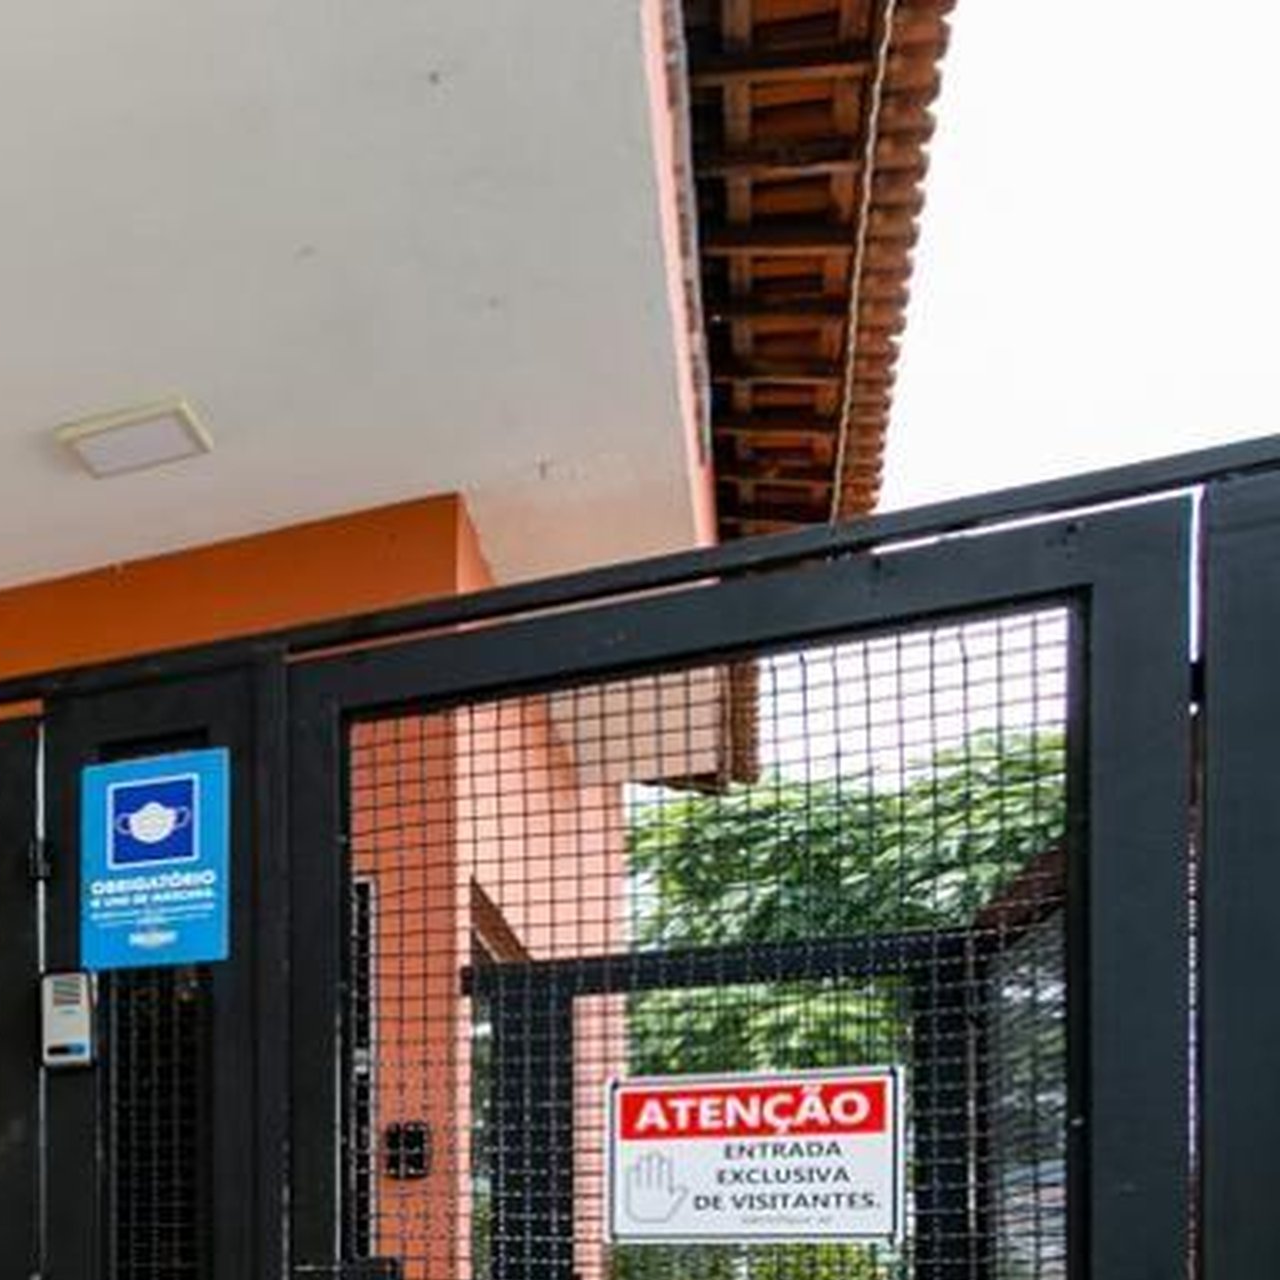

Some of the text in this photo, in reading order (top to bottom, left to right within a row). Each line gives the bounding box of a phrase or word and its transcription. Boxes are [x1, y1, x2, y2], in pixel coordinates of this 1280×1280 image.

[634, 1086, 870, 1134] ATENÇÃO
[724, 1141, 843, 1160] ENTRADA
[717, 1165, 850, 1185] EXCLUSIVA
[693, 1194, 726, 1212] DE
